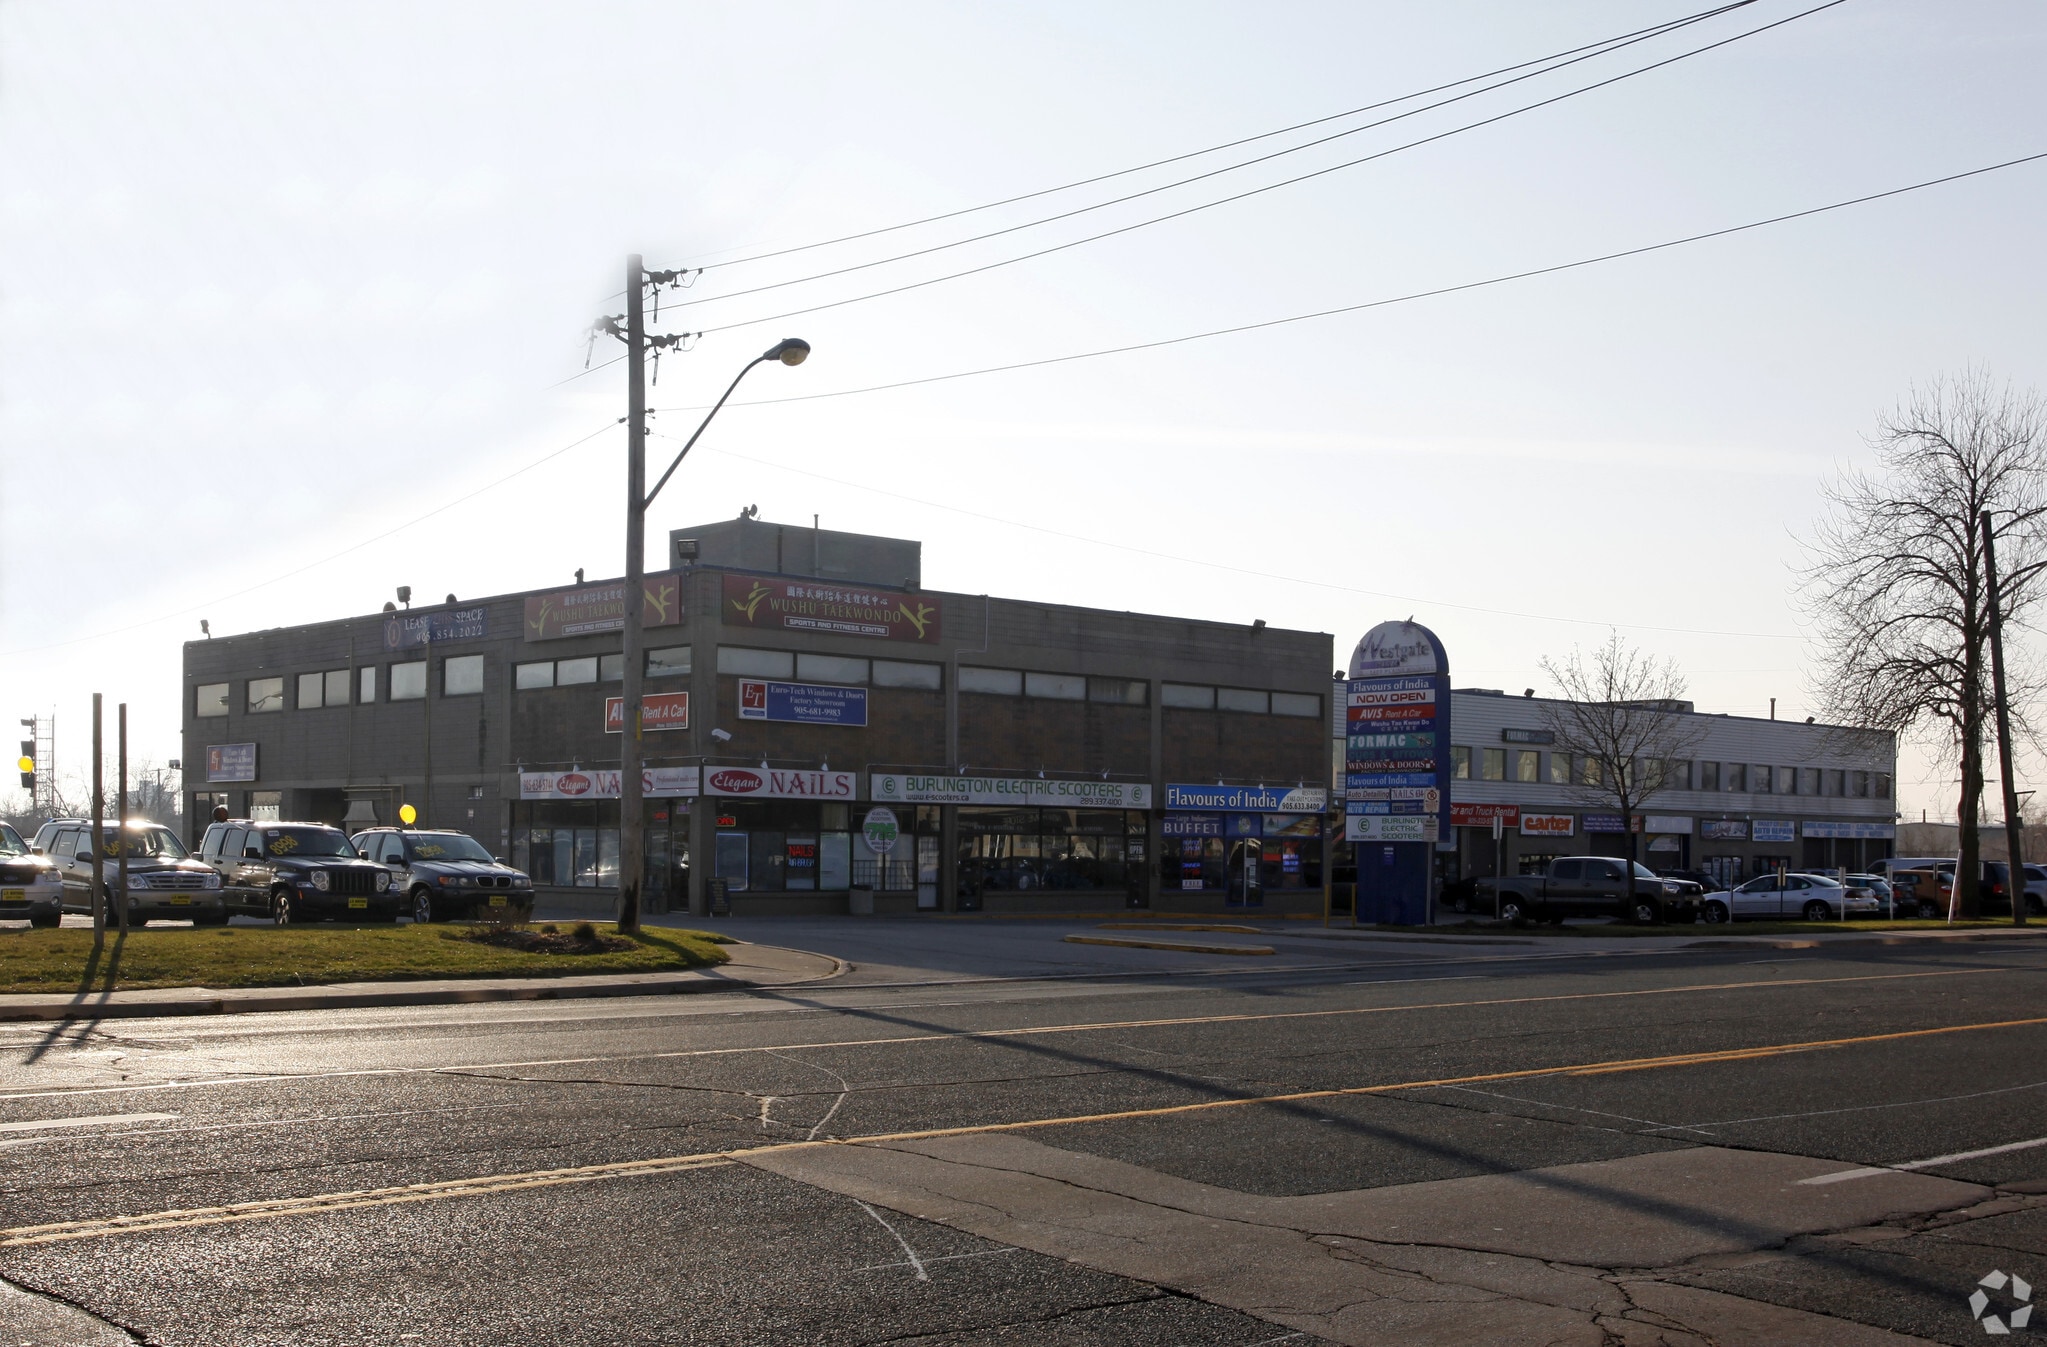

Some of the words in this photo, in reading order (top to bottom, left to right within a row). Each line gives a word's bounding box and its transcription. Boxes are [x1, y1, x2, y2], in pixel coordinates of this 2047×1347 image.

[456, 609, 484, 623] SPACE
[552, 608, 584, 622] WUSHU
[770, 597, 817, 615] WUSHU
[822, 603, 901, 624] TAEKWONDO
[789, 619, 816, 627] SPORTS
[833, 622, 860, 631] FITNESS
[860, 625, 886, 634] CENTRE
[1360, 633, 1430, 662] Westgate
[771, 685, 806, 695] Euro-Tech
[807, 687, 837, 697] Windows
[837, 690, 845, 698] &
[845, 691, 865, 699] Doors
[1353, 682, 1392, 692] Flavours
[1393, 680, 1404, 690] of
[1405, 679, 1430, 689] India
[790, 696, 812, 705] Factory
[814, 698, 846, 707] Showroom
[1356, 694, 1388, 704] NOW
[1390, 692, 1426, 702] OPEN
[643, 706, 661, 719] Rent
[662, 705, 670, 719] A
[671, 704, 685, 718] Car
[794, 706, 841, 717] 905-681-9983
[1360, 708, 1384, 719] AVIS
[1385, 710, 1402, 719] Rent
[1409, 709, 1422, 718] Car
[1350, 734, 1406, 748] FORMAC
[1348, 761, 1388, 770] WINDOWS
[1389, 761, 1395, 769] &
[1397, 760, 1425, 769] DOORS
[560, 775, 589, 794] Elegant
[595, 771, 654, 795] NAS
[714, 772, 760, 792] Elegant
[770, 772, 850, 796] NAILS
[1348, 775, 1378, 785] Flavours
[1379, 774, 1388, 785] of
[1388, 774, 1407, 785] India
[906, 777, 992, 793] BURLINGTON
[996, 780, 1055, 795] ELECTRIC
[1057, 782, 1122, 798] SCOOTERS
[906, 794, 969, 802] www.e-scooters.ca
[1168, 787, 1226, 807] Flavours
[1228, 790, 1243, 808] of
[1244, 790, 1278, 808] India
[1347, 790, 1361, 799] Auto
[1363, 790, 1390, 799] Detailing
[1392, 790, 1414, 799] NAILS
[1282, 802, 1321, 810] 905.633.8400
[1460, 806, 1474, 816] and
[1475, 805, 1494, 816] Truck
[1494, 806, 1517, 817] Rental
[716, 817, 735, 826] OPEN
[1524, 816, 1572, 832] carter
[1164, 823, 1220, 834] BUFFET
[788, 845, 815, 858] NAILS
